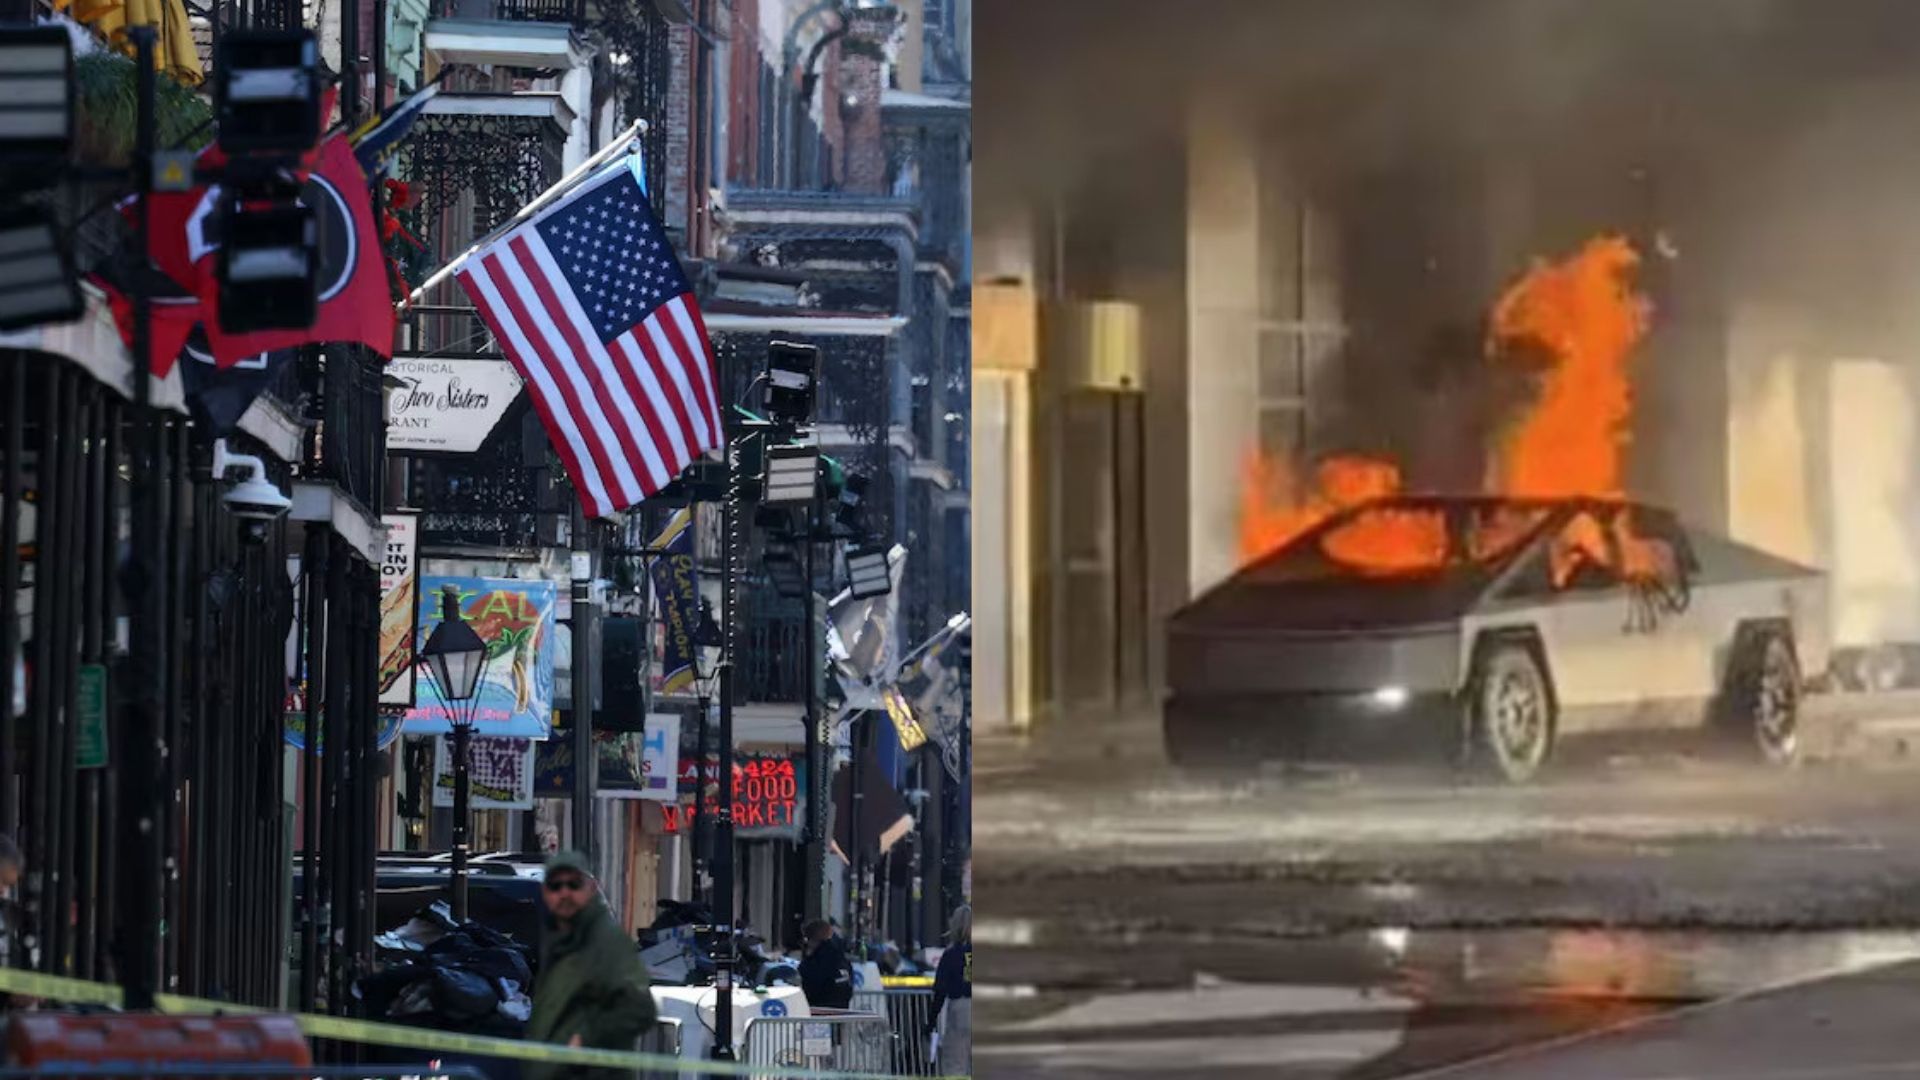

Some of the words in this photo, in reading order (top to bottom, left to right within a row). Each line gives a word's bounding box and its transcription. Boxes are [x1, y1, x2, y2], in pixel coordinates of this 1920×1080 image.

[392, 376, 434, 415] Two
[436, 376, 489, 412] Sisters
[731, 774, 797, 801] FOOD
